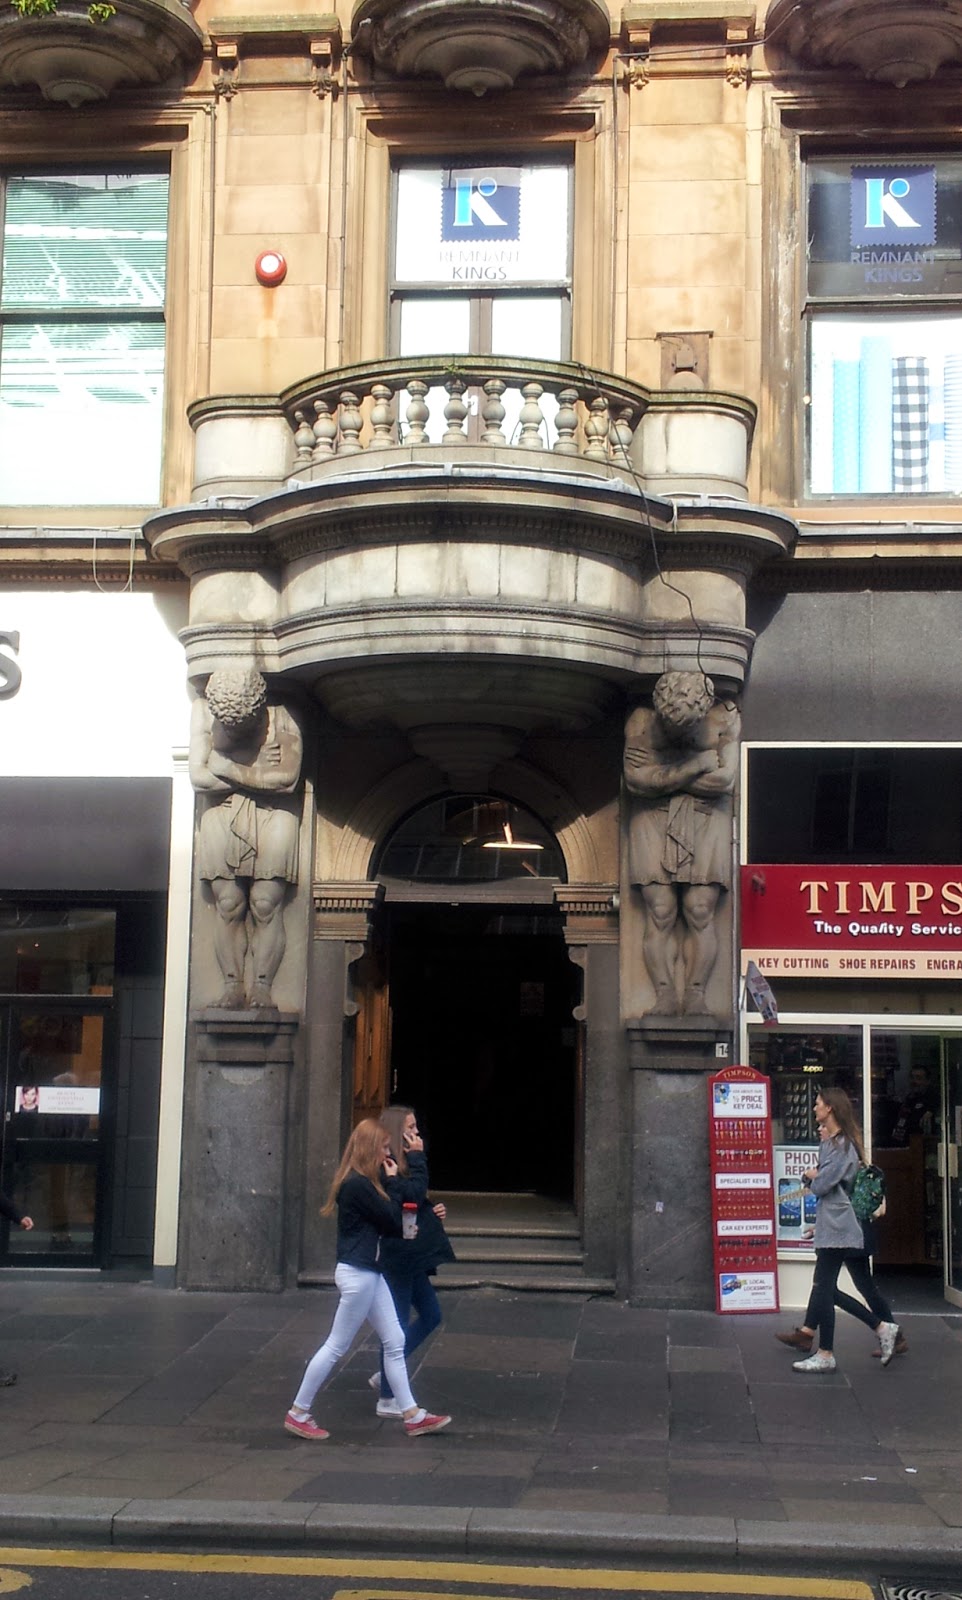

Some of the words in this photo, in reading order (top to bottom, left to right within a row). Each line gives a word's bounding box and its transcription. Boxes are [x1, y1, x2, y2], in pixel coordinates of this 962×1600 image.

[439, 250, 520, 263] REMNANT
[851, 251, 935, 265] REMNANT
[452, 266, 507, 280] KINGS
[864, 267, 924, 283] KINGS
[800, 880, 962, 915] TIMPS
[813, 920, 842, 934] The
[848, 922, 904, 937] Quality
[758, 957, 779, 968] KEY
[783, 958, 829, 968] CUTTING
[839, 958, 867, 969] SHOE
[870, 959, 916, 970] REPAIRS
[723, 1069, 756, 1079] TIMPSON
[741, 1095, 763, 1103] PRICE
[785, 1165, 817, 1176] REP
